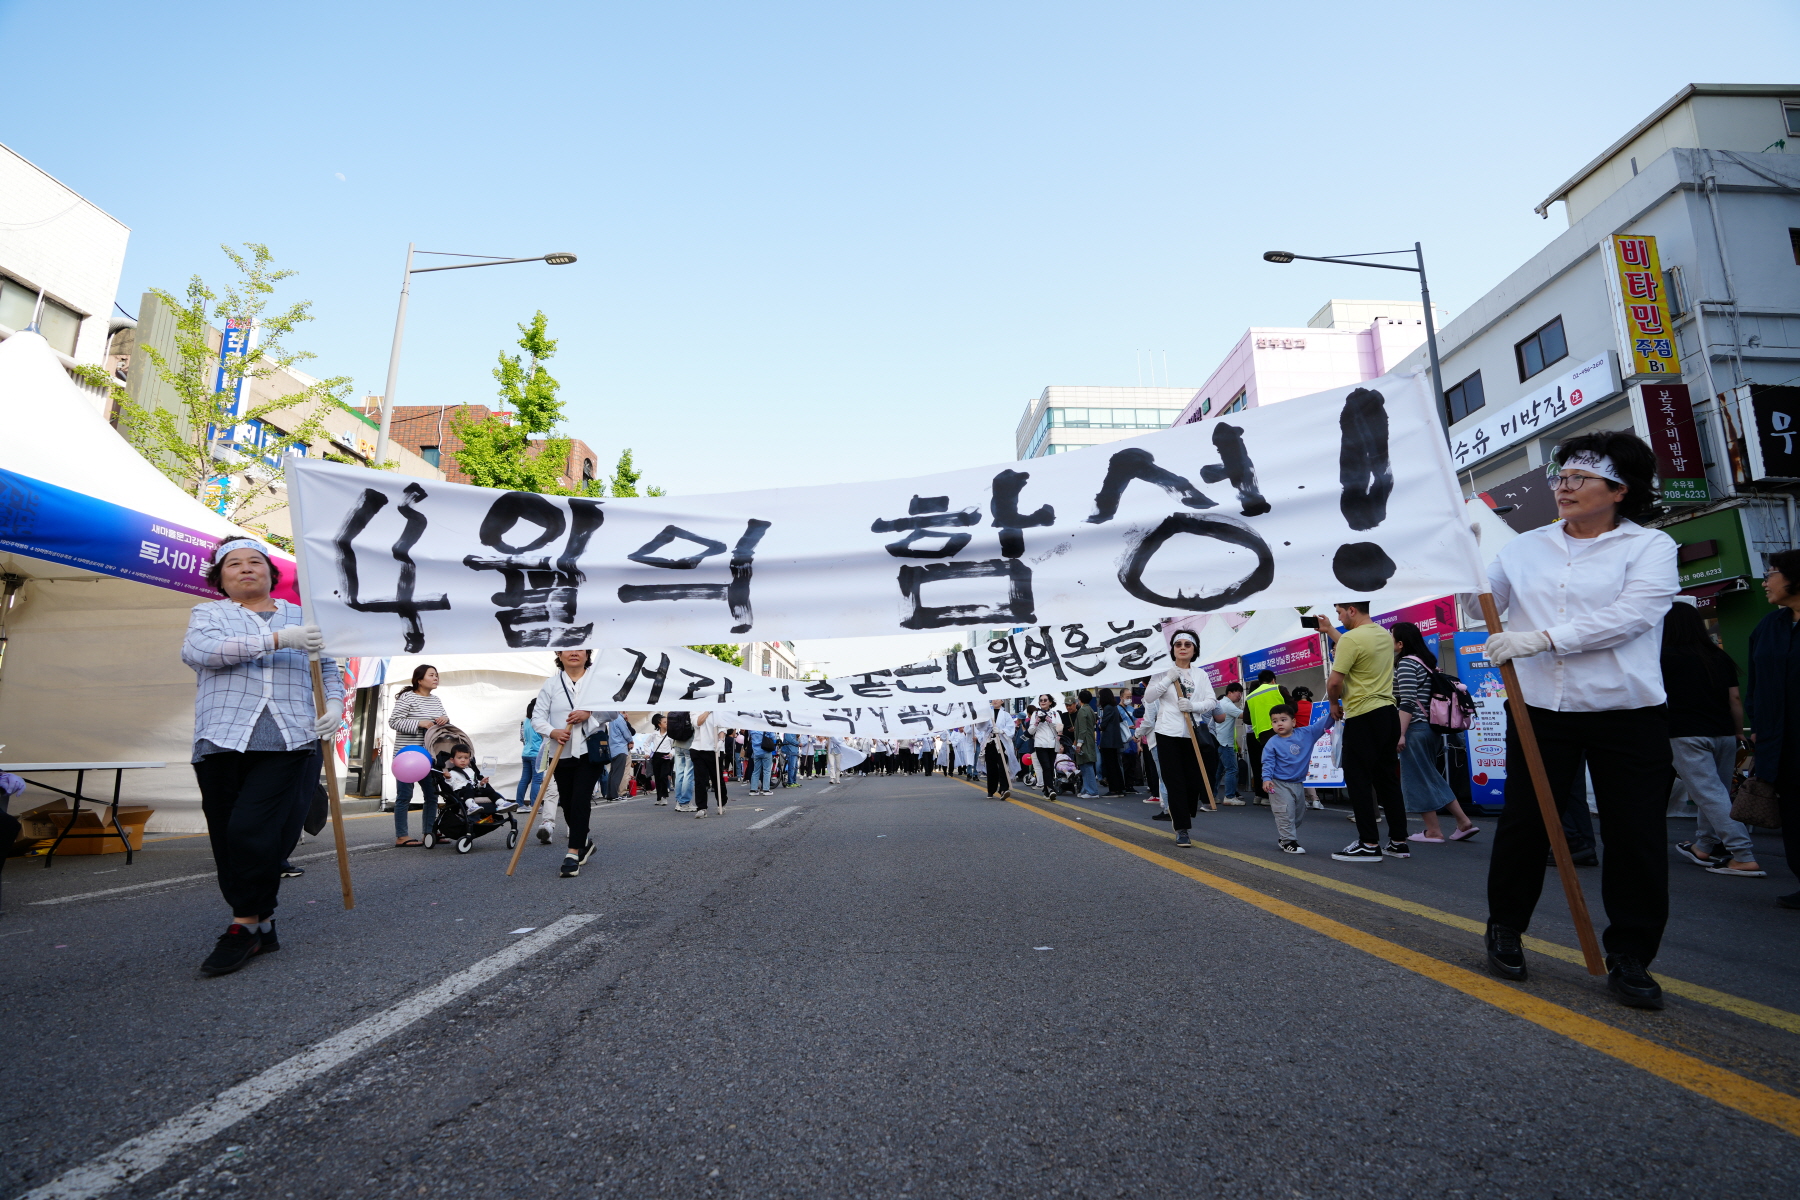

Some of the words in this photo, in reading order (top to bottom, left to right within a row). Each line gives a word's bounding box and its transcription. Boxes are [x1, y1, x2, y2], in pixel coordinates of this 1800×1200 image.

[1618, 239, 1664, 335] 비타민
[1636, 339, 1673, 358] 주점
[1649, 360, 1666, 373] B1
[1658, 389, 1688, 472] 본죽&비빔밥
[1664, 490, 1706, 499] 908-6233
[1672, 480, 1694, 489] 수유점
[871, 387, 1398, 629] 함성!
[151, 523, 221, 551] 새마을문고강북구
[139, 540, 197, 574] 독서야
